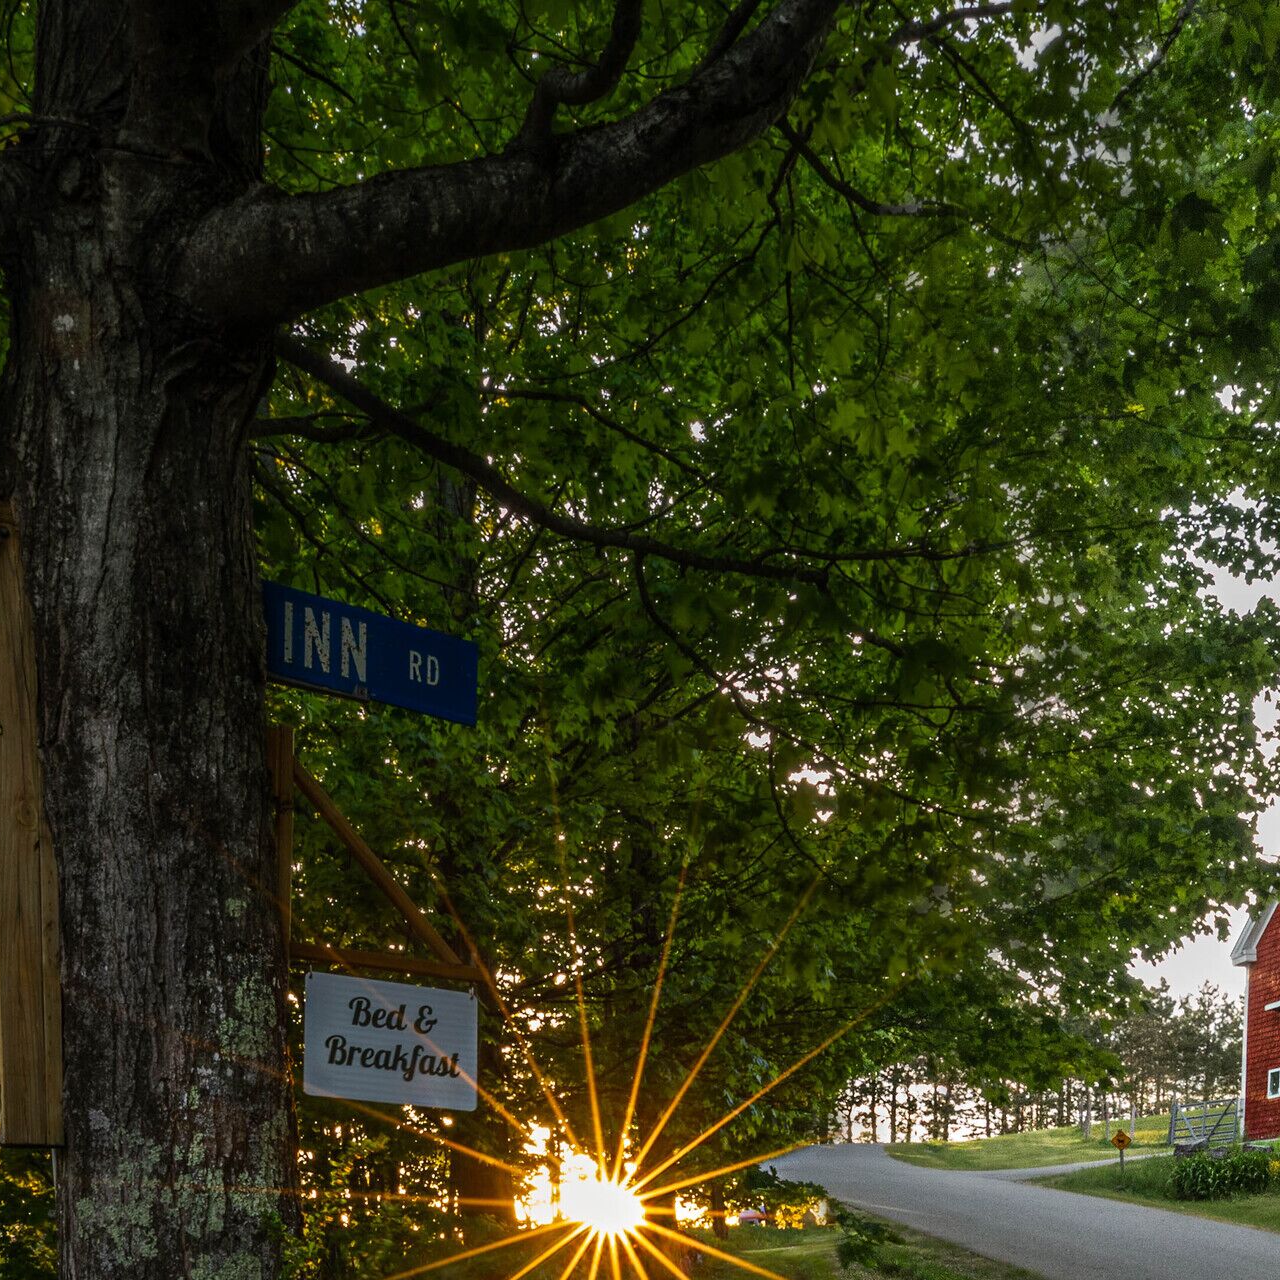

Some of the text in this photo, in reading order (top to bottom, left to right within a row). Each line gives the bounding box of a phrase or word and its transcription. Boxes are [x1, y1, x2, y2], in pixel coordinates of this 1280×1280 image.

[284, 601, 440, 686] INN RD
[348, 996, 438, 1035] Bed &
[325, 1034, 461, 1082] Breakfast
